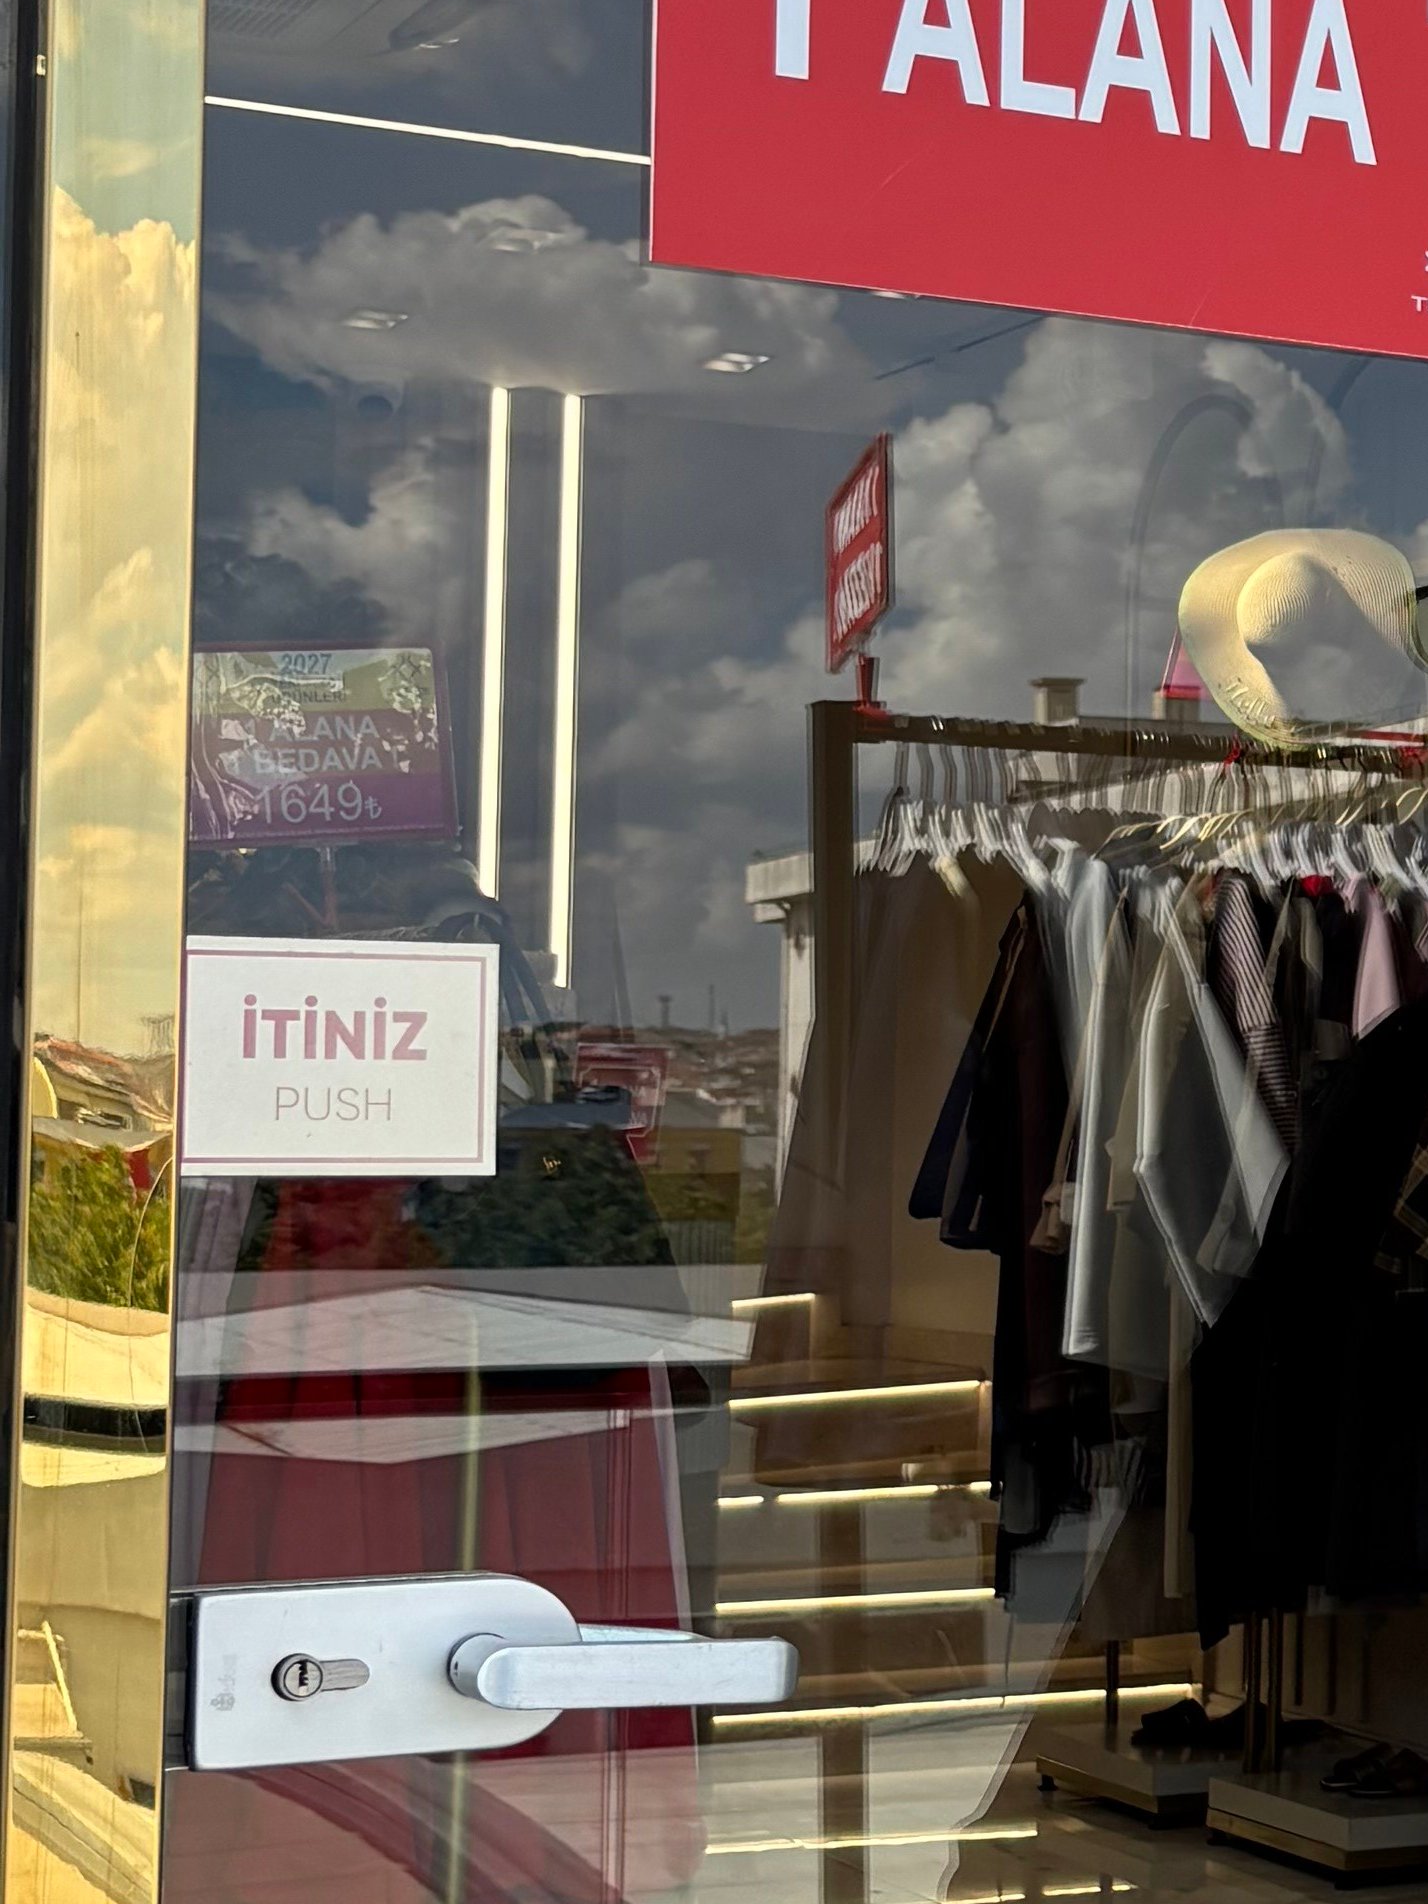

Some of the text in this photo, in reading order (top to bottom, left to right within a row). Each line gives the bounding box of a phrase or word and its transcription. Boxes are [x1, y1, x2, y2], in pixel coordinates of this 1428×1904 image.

[253, 746, 383, 775] BEDAVA
[241, 993, 428, 1061] İTİNİZ
[274, 1086, 392, 1121] PUSH
